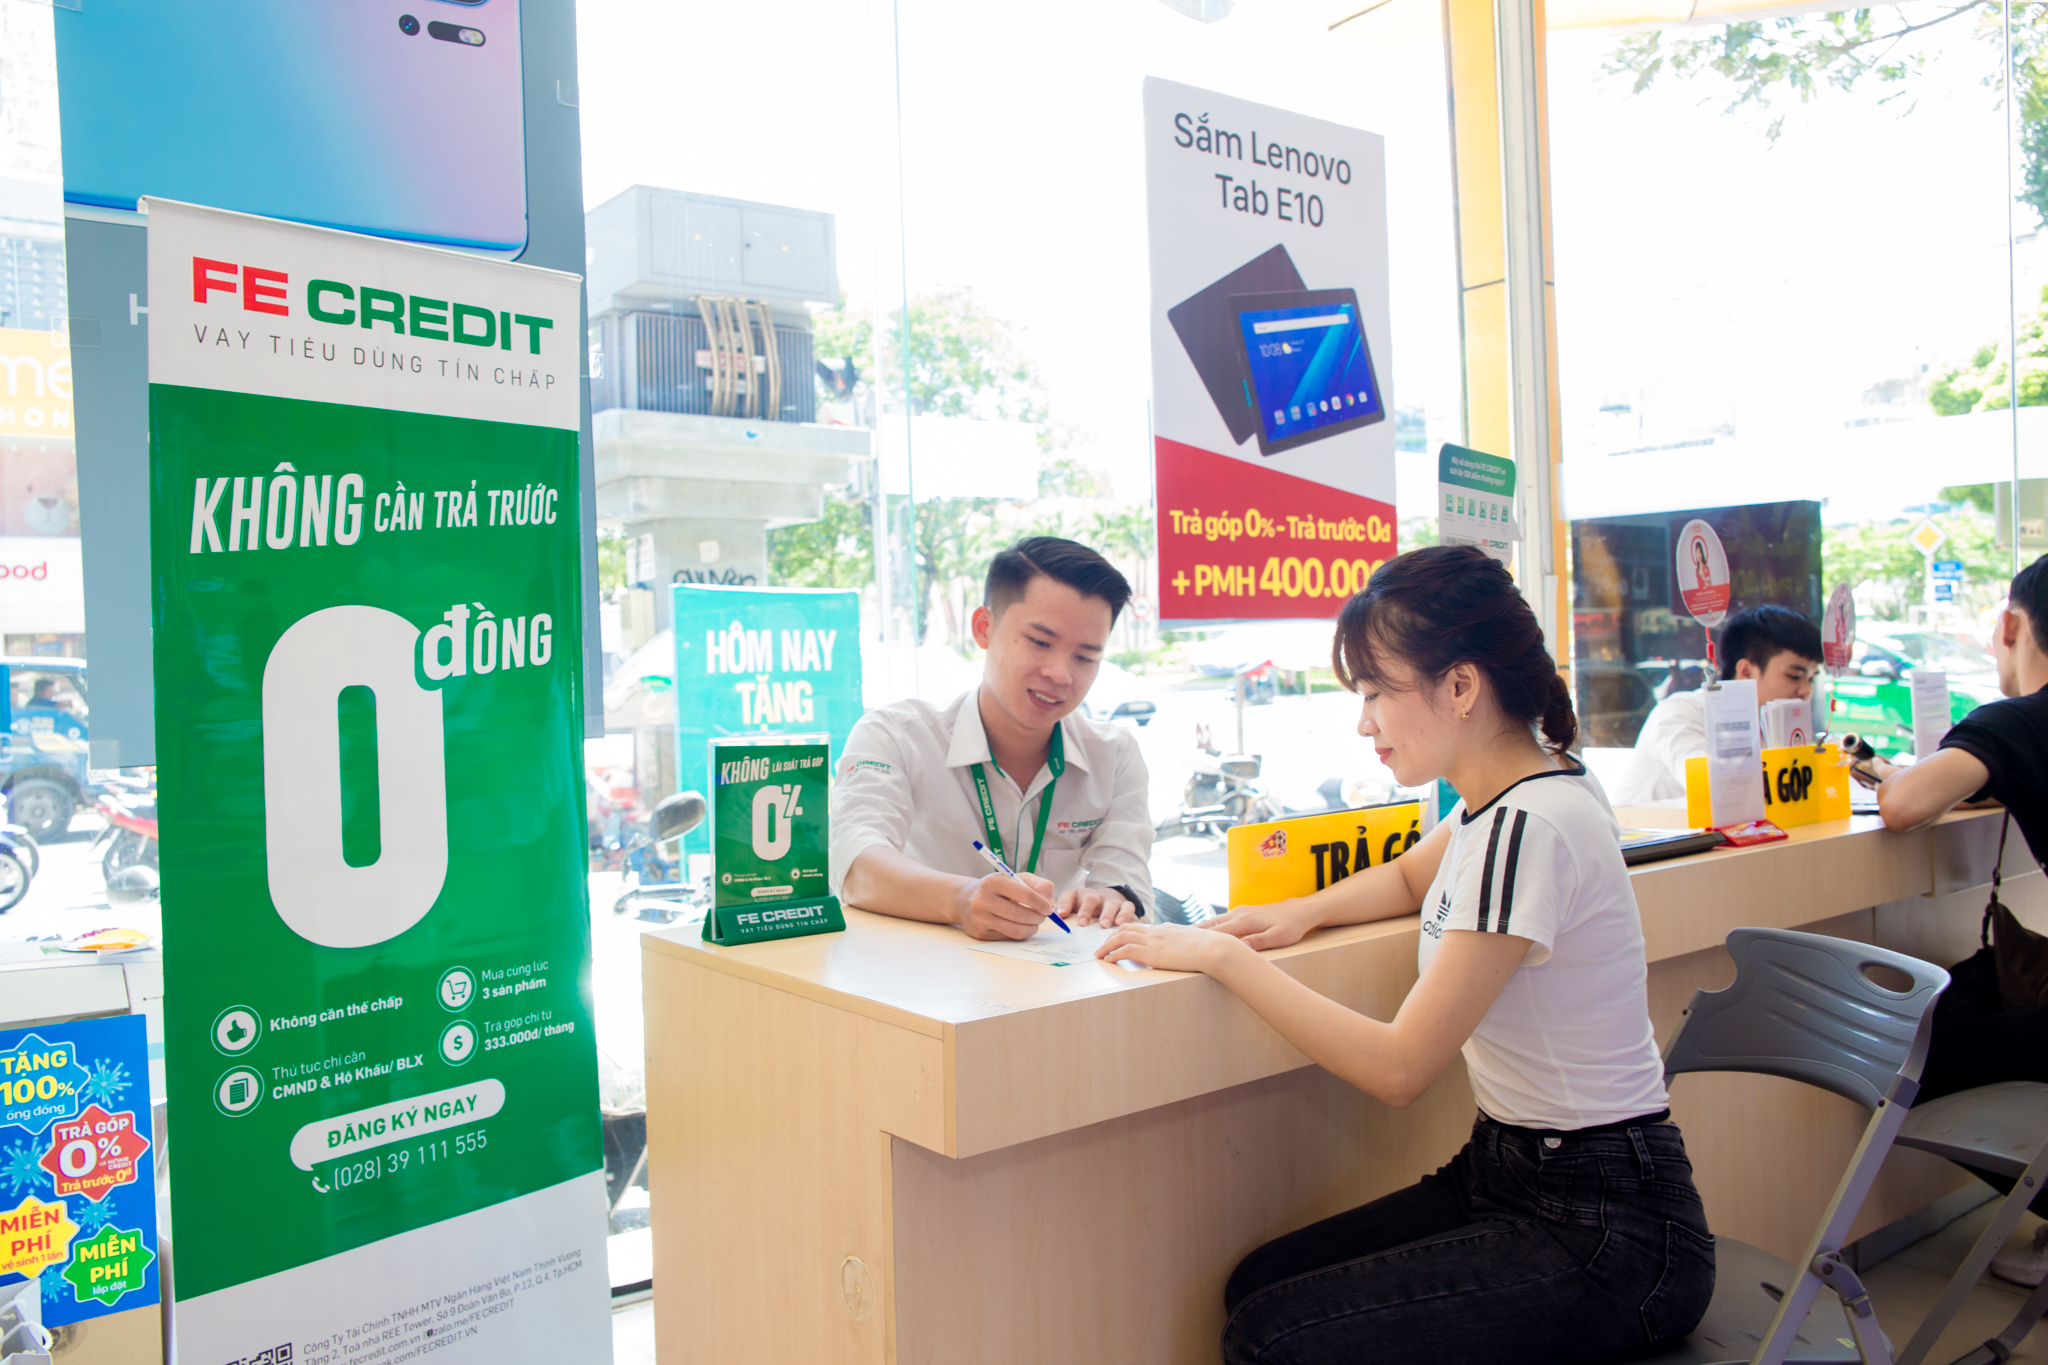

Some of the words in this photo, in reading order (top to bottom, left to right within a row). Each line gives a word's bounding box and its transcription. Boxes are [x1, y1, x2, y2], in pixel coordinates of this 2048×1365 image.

[1174, 112, 1242, 161] Sắm
[1251, 130, 1352, 185] Lenovo
[1214, 173, 1269, 216] Tab
[1277, 187, 1324, 228] E10
[193, 256, 289, 317] FE
[307, 279, 554, 355] CREDIT
[194, 323, 251, 350] VAY
[269, 335, 336, 361] TIÊU
[353, 346, 423, 373] DÙNG
[438, 358, 480, 381] TÍN
[494, 366, 555, 390] CHẤP
[190, 461, 365, 554] KHÔNG
[374, 480, 425, 533] CẦN
[434, 479, 478, 529] TRẢ
[487, 483, 558, 527] TRƯỚC
[1169, 508, 1203, 535] Trả
[1205, 510, 1243, 543] góp
[1245, 508, 1276, 538] 0%
[1286, 514, 1316, 540] Trả
[1318, 516, 1366, 542] trước
[1195, 564, 1256, 597] PMH
[1260, 556, 1386, 598] 400.00
[706, 619, 774, 675] HÔM
[781, 629, 838, 672] NAY
[735, 673, 814, 732] TẶNG
[262, 605, 448, 948] 0
[720, 756, 770, 785] KHÔNG
[1777, 759, 1813, 803] GÓP
[977, 778, 992, 816] CREDIT
[752, 784, 803, 861] 0%
[986, 817, 996, 830] FE
[1057, 821, 1070, 829] FE
[1310, 825, 1371, 892] TRẢ
[736, 913, 760, 925] FE
[761, 905, 824, 923] CREDIT
[481, 968, 504, 982] Mua
[482, 987, 490, 1000] 3
[269, 1013, 317, 1032] Không
[319, 1008, 344, 1023] cần
[346, 1000, 369, 1017] thế
[370, 995, 404, 1013] chấp
[0, 1050, 68, 1077] TẶNG
[272, 1078, 318, 1100] CMND
[319, 1075, 332, 1090] &
[334, 1071, 353, 1085] Hộ
[396, 1054, 424, 1072] BLX
[300, 1060, 321, 1076] tục
[344, 1050, 366, 1065] cần
[0, 1075, 75, 1106] 100%
[58, 1121, 92, 1141] TRẢ
[95, 1117, 130, 1135] GÓP
[327, 1117, 386, 1149] ĐĂNG
[391, 1105, 419, 1131] KÝ
[423, 1094, 478, 1123] NGAY
[59, 1135, 122, 1179] 0%
[334, 1155, 381, 1191] (028)
[387, 1150, 410, 1173] 39
[417, 1140, 448, 1165] 111
[455, 1129, 487, 1155] 555
[61, 1180, 81, 1193] Trả
[82, 1174, 115, 1189] trước
[0, 1205, 60, 1235] MIỄN
[11, 1229, 53, 1257] PHÍ
[17, 1255, 39, 1267] sinh
[79, 1233, 136, 1263] MIỄN
[90, 1256, 129, 1284] PHÍ
[303, 1339, 330, 1355] Công
[331, 1334, 344, 1346] Ty
[391, 1306, 419, 1323] TNHH
[420, 1297, 442, 1313] MTV
[443, 1290, 468, 1305] Ngân
[512, 1266, 532, 1280] Nam
[362, 1335, 380, 1349] nhà
[381, 1325, 401, 1341] REE
[436, 1309, 449, 1322] Số
[449, 1305, 456, 1317] 9
